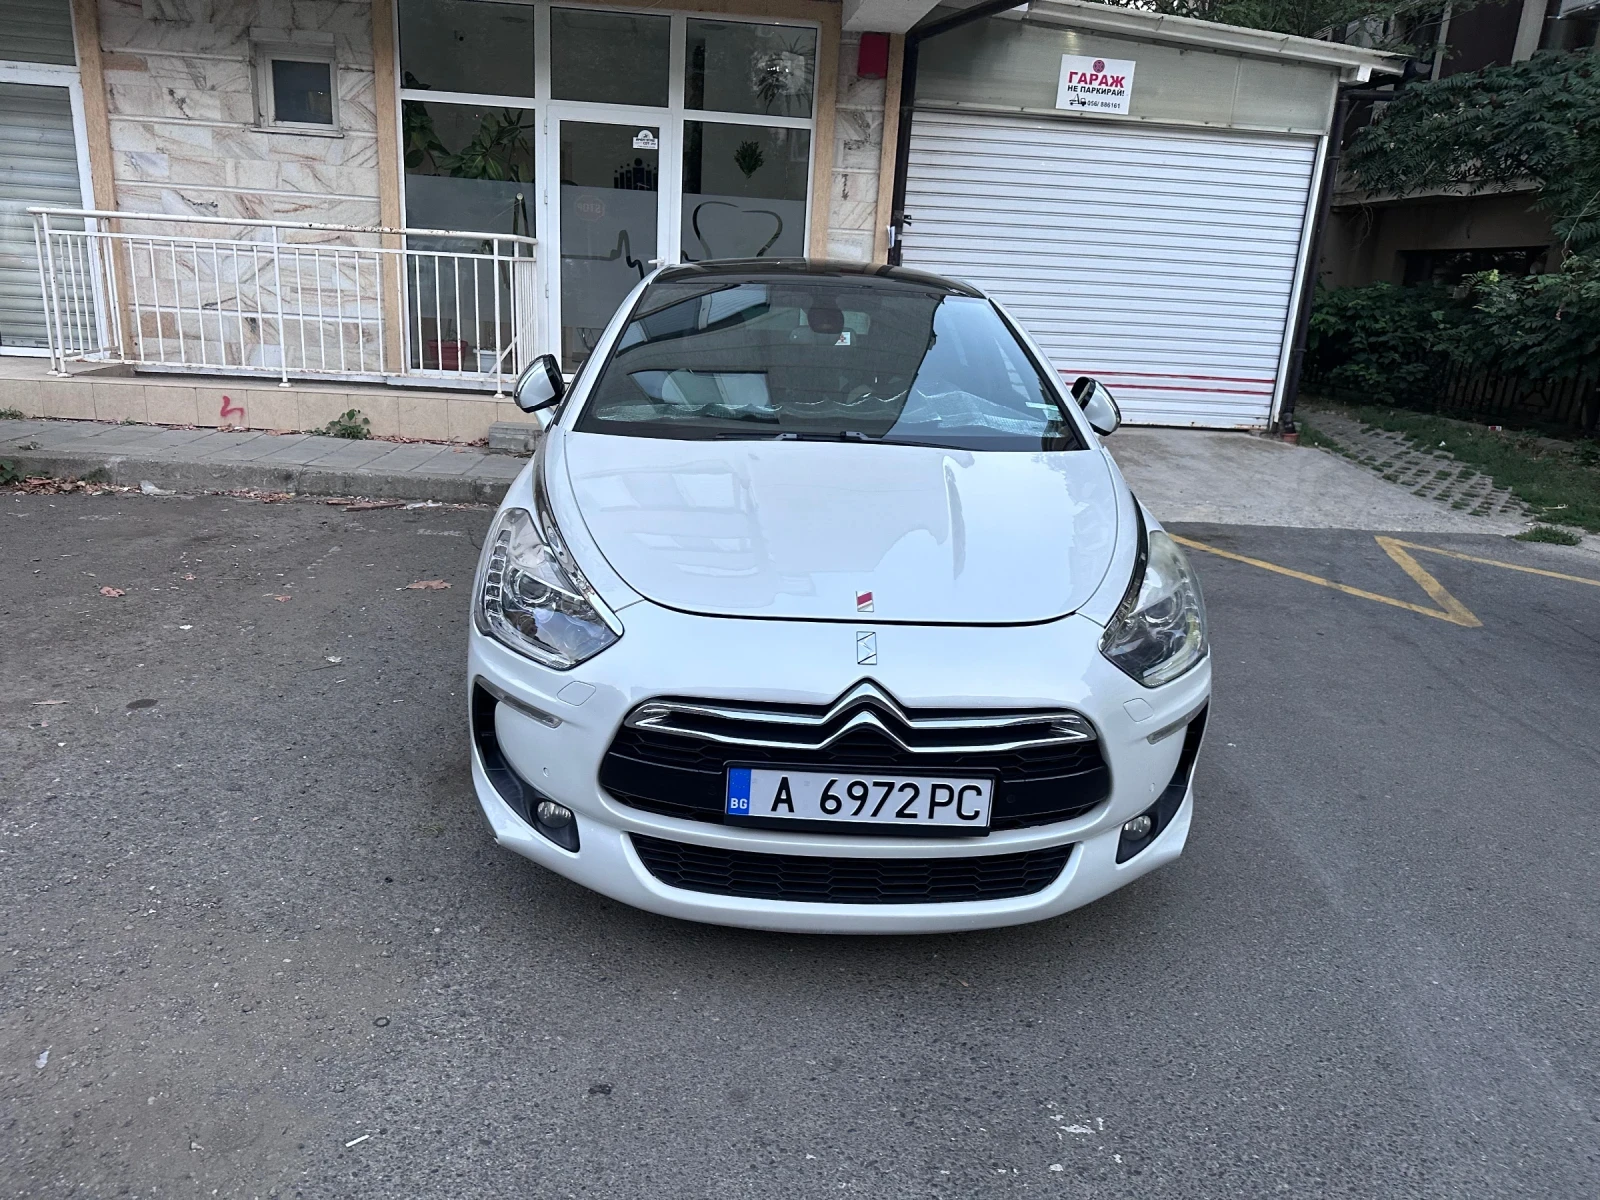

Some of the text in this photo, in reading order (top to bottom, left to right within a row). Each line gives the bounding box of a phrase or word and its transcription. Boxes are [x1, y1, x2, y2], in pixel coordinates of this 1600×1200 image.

[1068, 71, 1125, 88] ГАРАЖ
[1067, 84, 1125, 96] НЕ ПАРКИРАЙ!
[770, 776, 795, 813] A
[730, 797, 748, 809] BG
